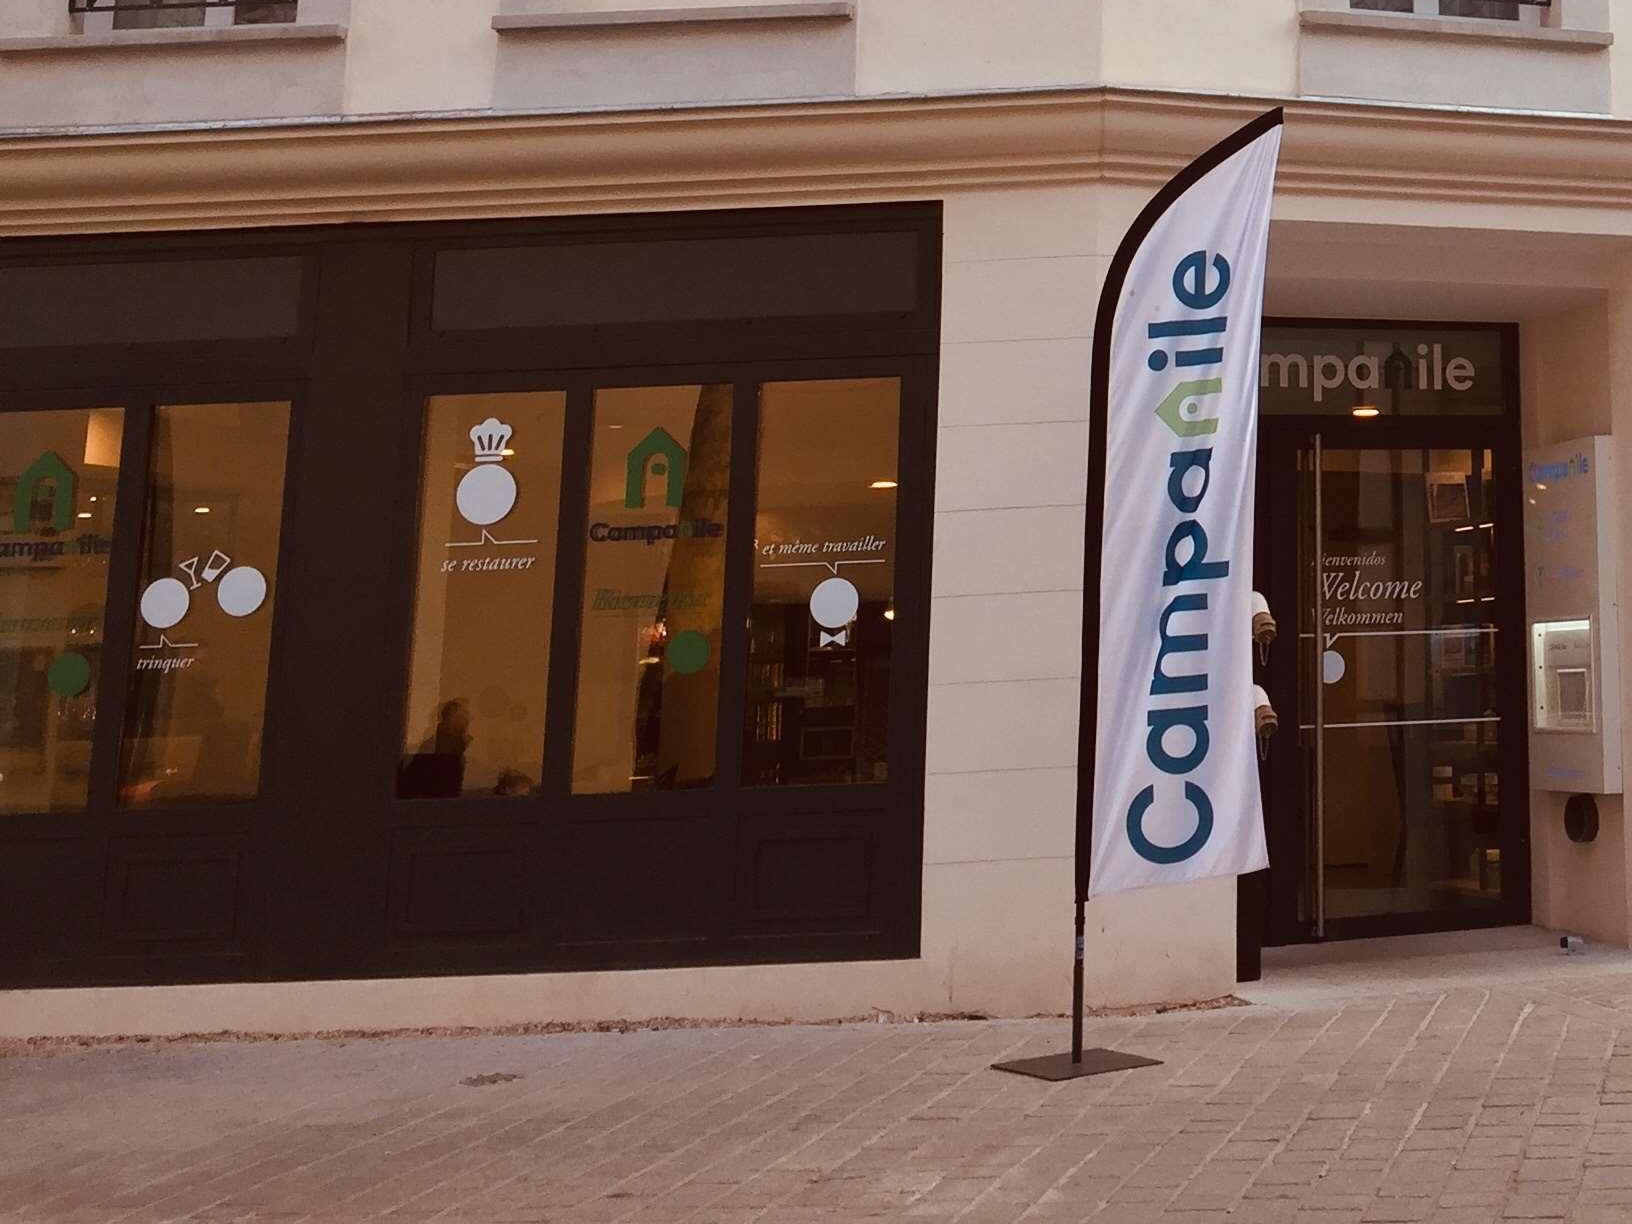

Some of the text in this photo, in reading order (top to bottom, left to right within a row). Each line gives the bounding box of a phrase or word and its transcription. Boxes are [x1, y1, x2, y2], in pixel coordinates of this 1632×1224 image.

[1261, 344, 1475, 402] mpanile
[762, 543, 774, 555] et
[778, 539, 818, 554] même
[822, 535, 886, 553] travailler
[440, 555, 535, 573] se restaurer
[1126, 248, 1230, 865] Campanile
[1312, 551, 1386, 566] ienvenidos
[1322, 571, 1423, 600] Welcome
[136, 656, 194, 674] trinquer
